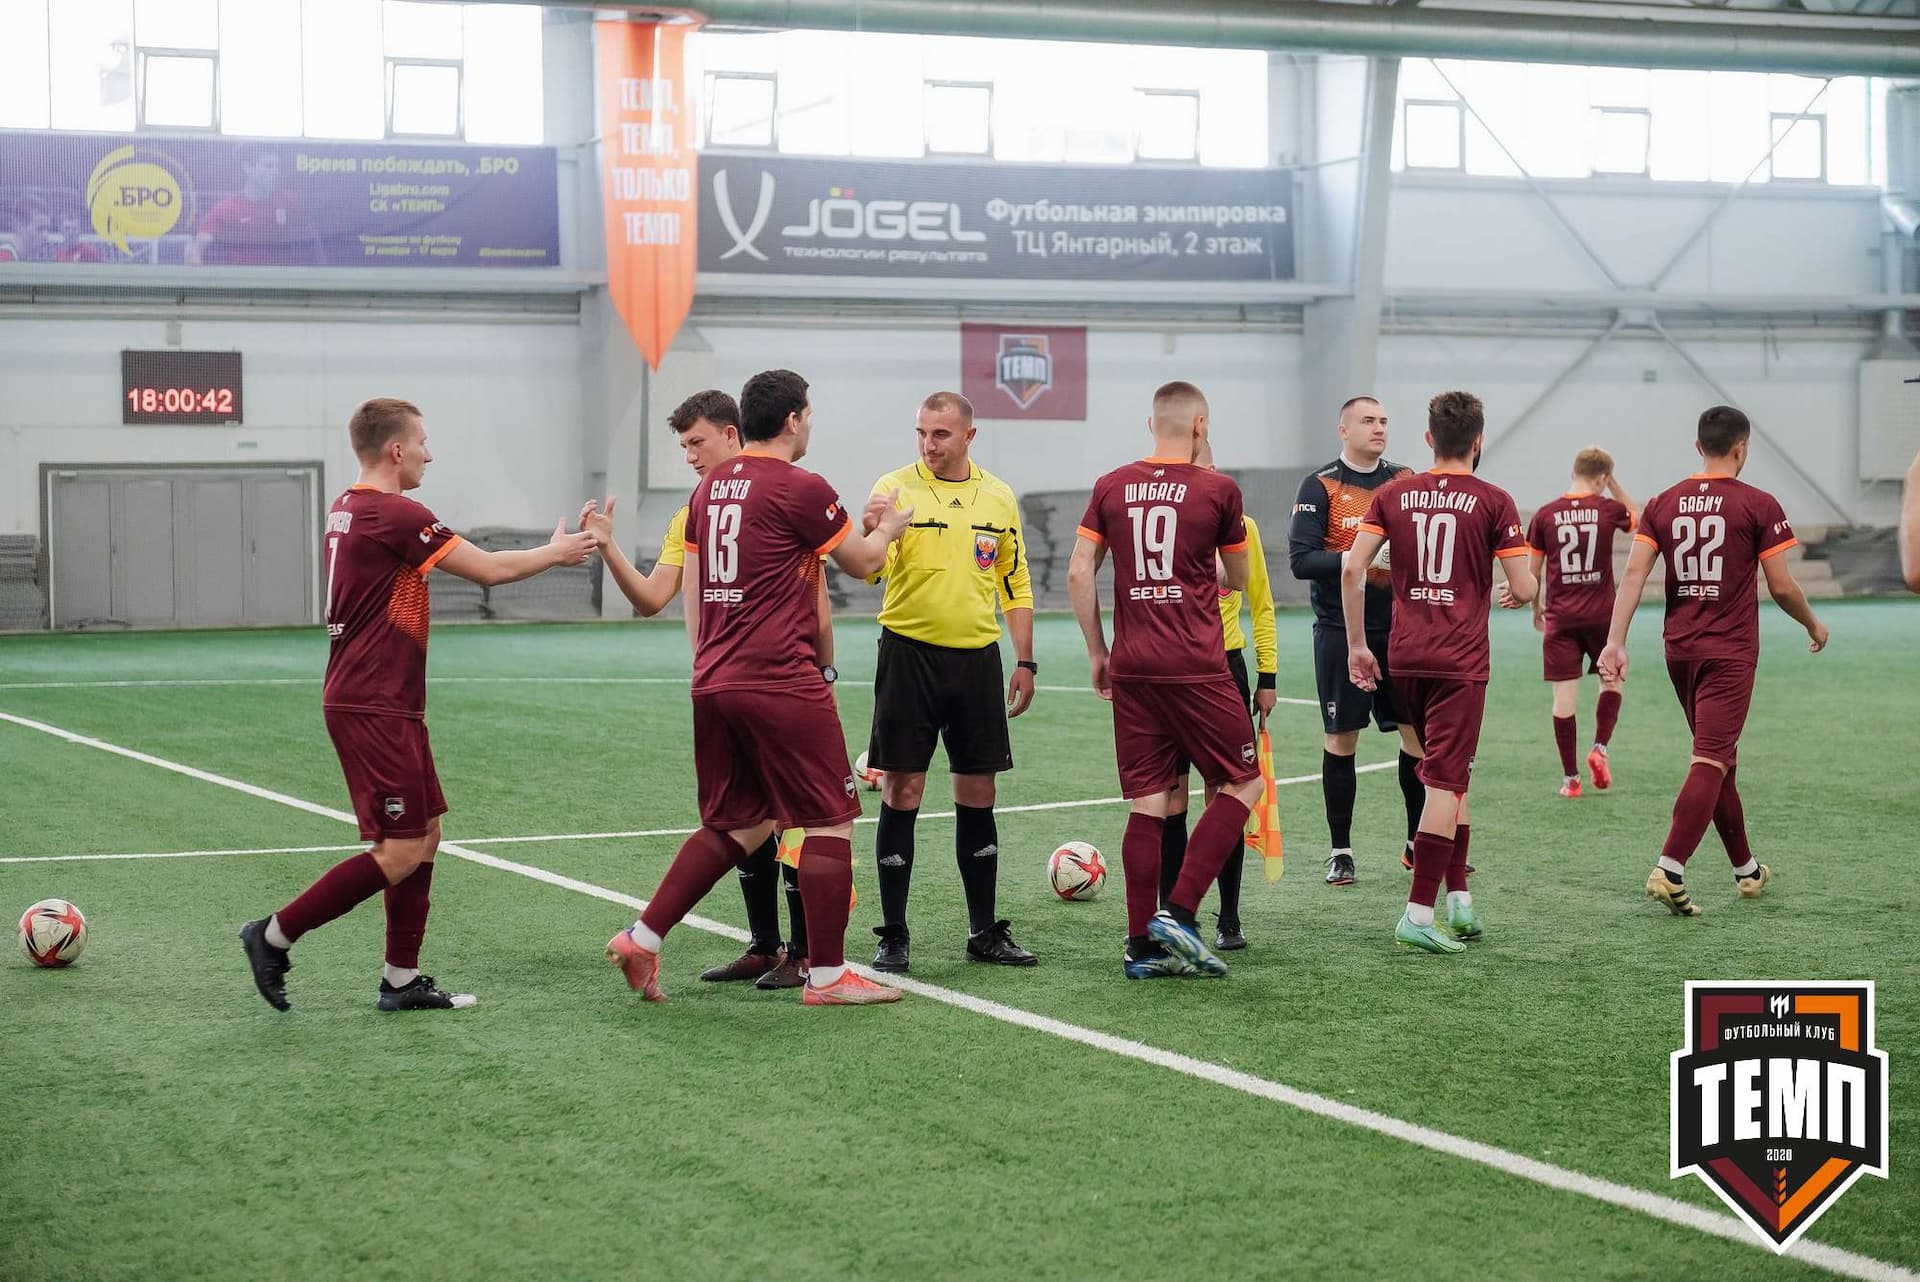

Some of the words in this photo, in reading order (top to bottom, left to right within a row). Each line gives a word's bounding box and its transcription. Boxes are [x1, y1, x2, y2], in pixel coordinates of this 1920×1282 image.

[296, 155, 356, 175] Время
[362, 156, 470, 176] побеждать,
[475, 157, 519, 175] .БРО
[611, 167, 689, 201] ТОЛЬКО
[114, 186, 173, 207] .БРО
[369, 199, 388, 212] СК
[781, 187, 987, 242] JÖGEL
[985, 198, 1138, 226] Футбольная
[1143, 204, 1287, 227] экипировка
[624, 212, 681, 246] ТЕМП!
[1012, 231, 1047, 257] ТЦ
[1051, 231, 1179, 258] Янтарный,
[1184, 232, 1199, 253] 2
[1205, 236, 1263, 254] этаж
[128, 388, 233, 412] 18:00:42
[710, 480, 751, 500] СЫЧЕВ
[1124, 482, 1187, 504] ШИБАЕВ
[1401, 490, 1478, 514] АПАЛЬКИН
[1679, 496, 1723, 513] БАБИЧ
[1554, 509, 1599, 527] ЖДАНОВ
[707, 504, 742, 583] 13
[1128, 506, 1178, 581] 19
[1412, 512, 1457, 584] 10
[1557, 524, 1598, 573] 27
[1671, 515, 1726, 581] 22
[1130, 586, 1183, 600] SEUS
[1410, 587, 1455, 600] SEUS
[1677, 585, 1720, 597] SEUS
